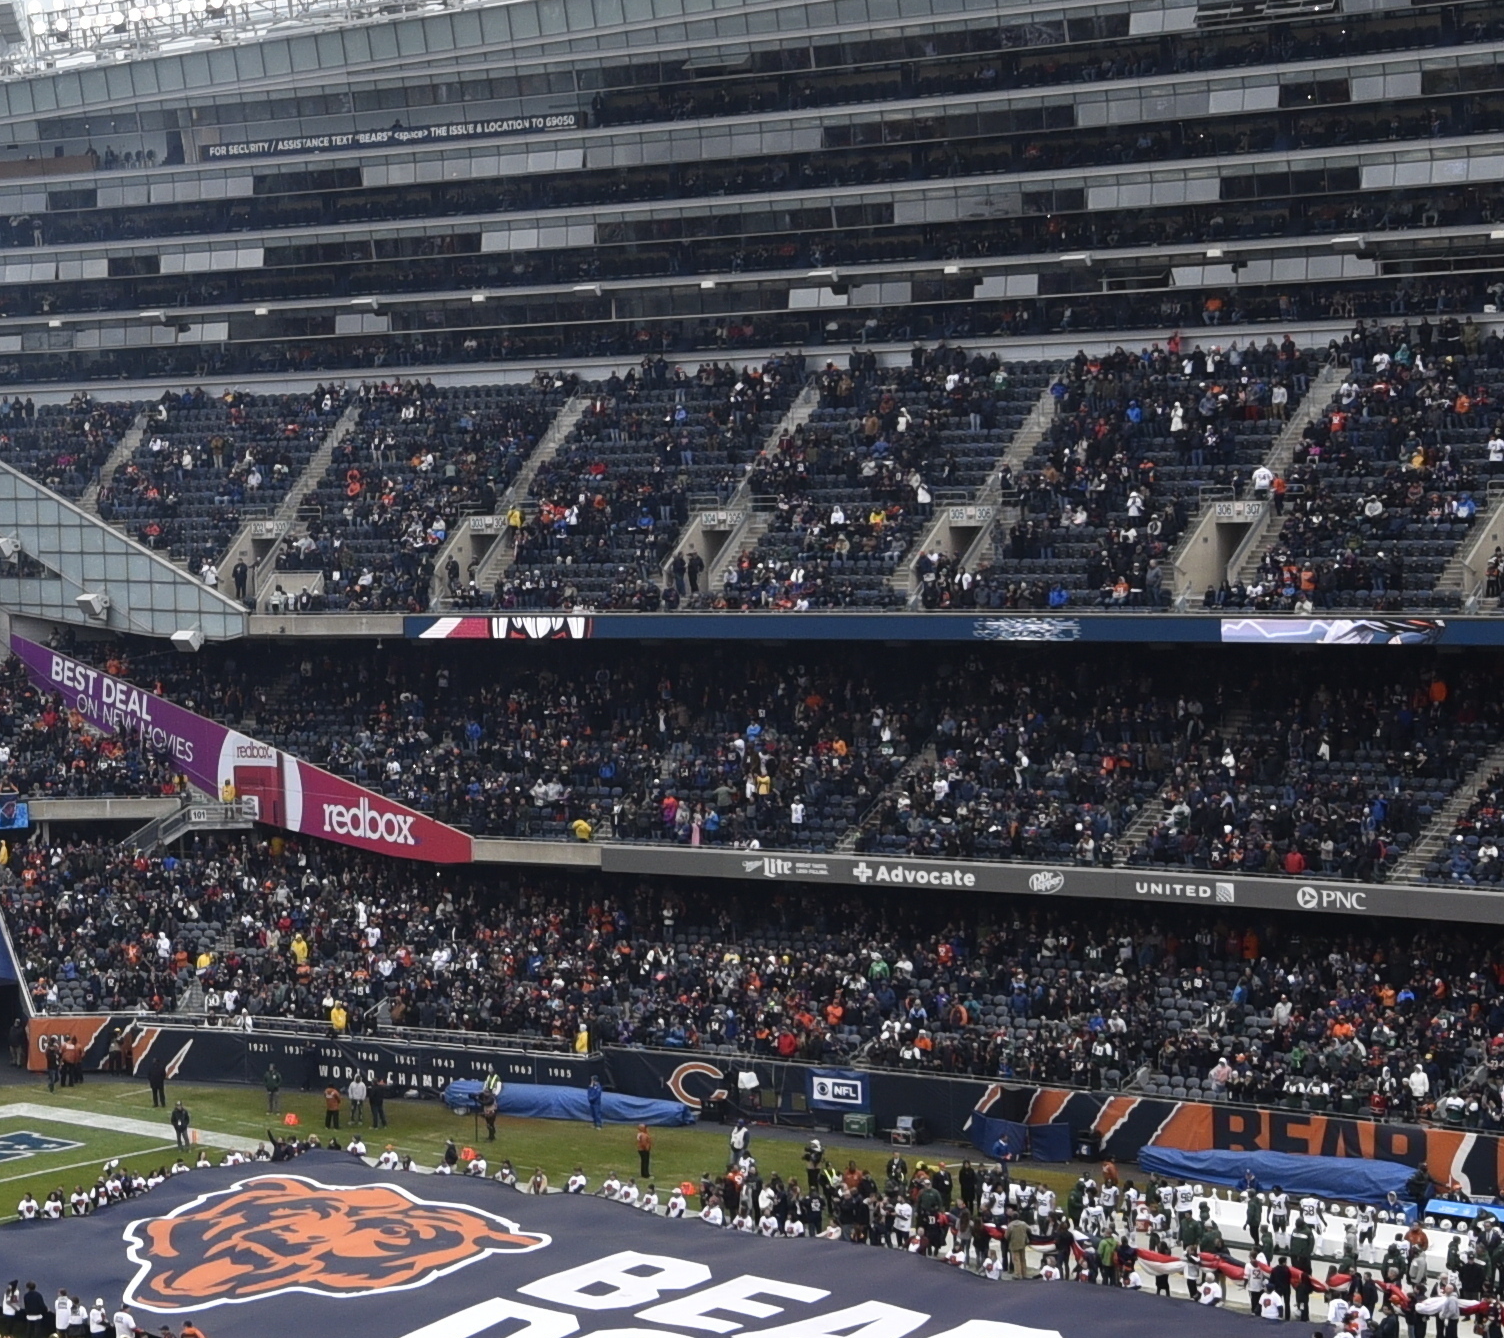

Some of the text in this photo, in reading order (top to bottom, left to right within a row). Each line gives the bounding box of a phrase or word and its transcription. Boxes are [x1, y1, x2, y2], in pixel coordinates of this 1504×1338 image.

[51, 654, 152, 722] BEST DEAL
[75, 694, 98, 720] ON
[192, 811, 206, 821] 101
[763, 857, 792, 878] Lite
[876, 865, 976, 888] Advocate
[1135, 882, 1211, 898] UNITED
[1320, 889, 1367, 910] PNC
[248, 1042, 269, 1054] 1921
[509, 1064, 533, 1076] 1963
[833, 1083, 857, 1098] NFL
